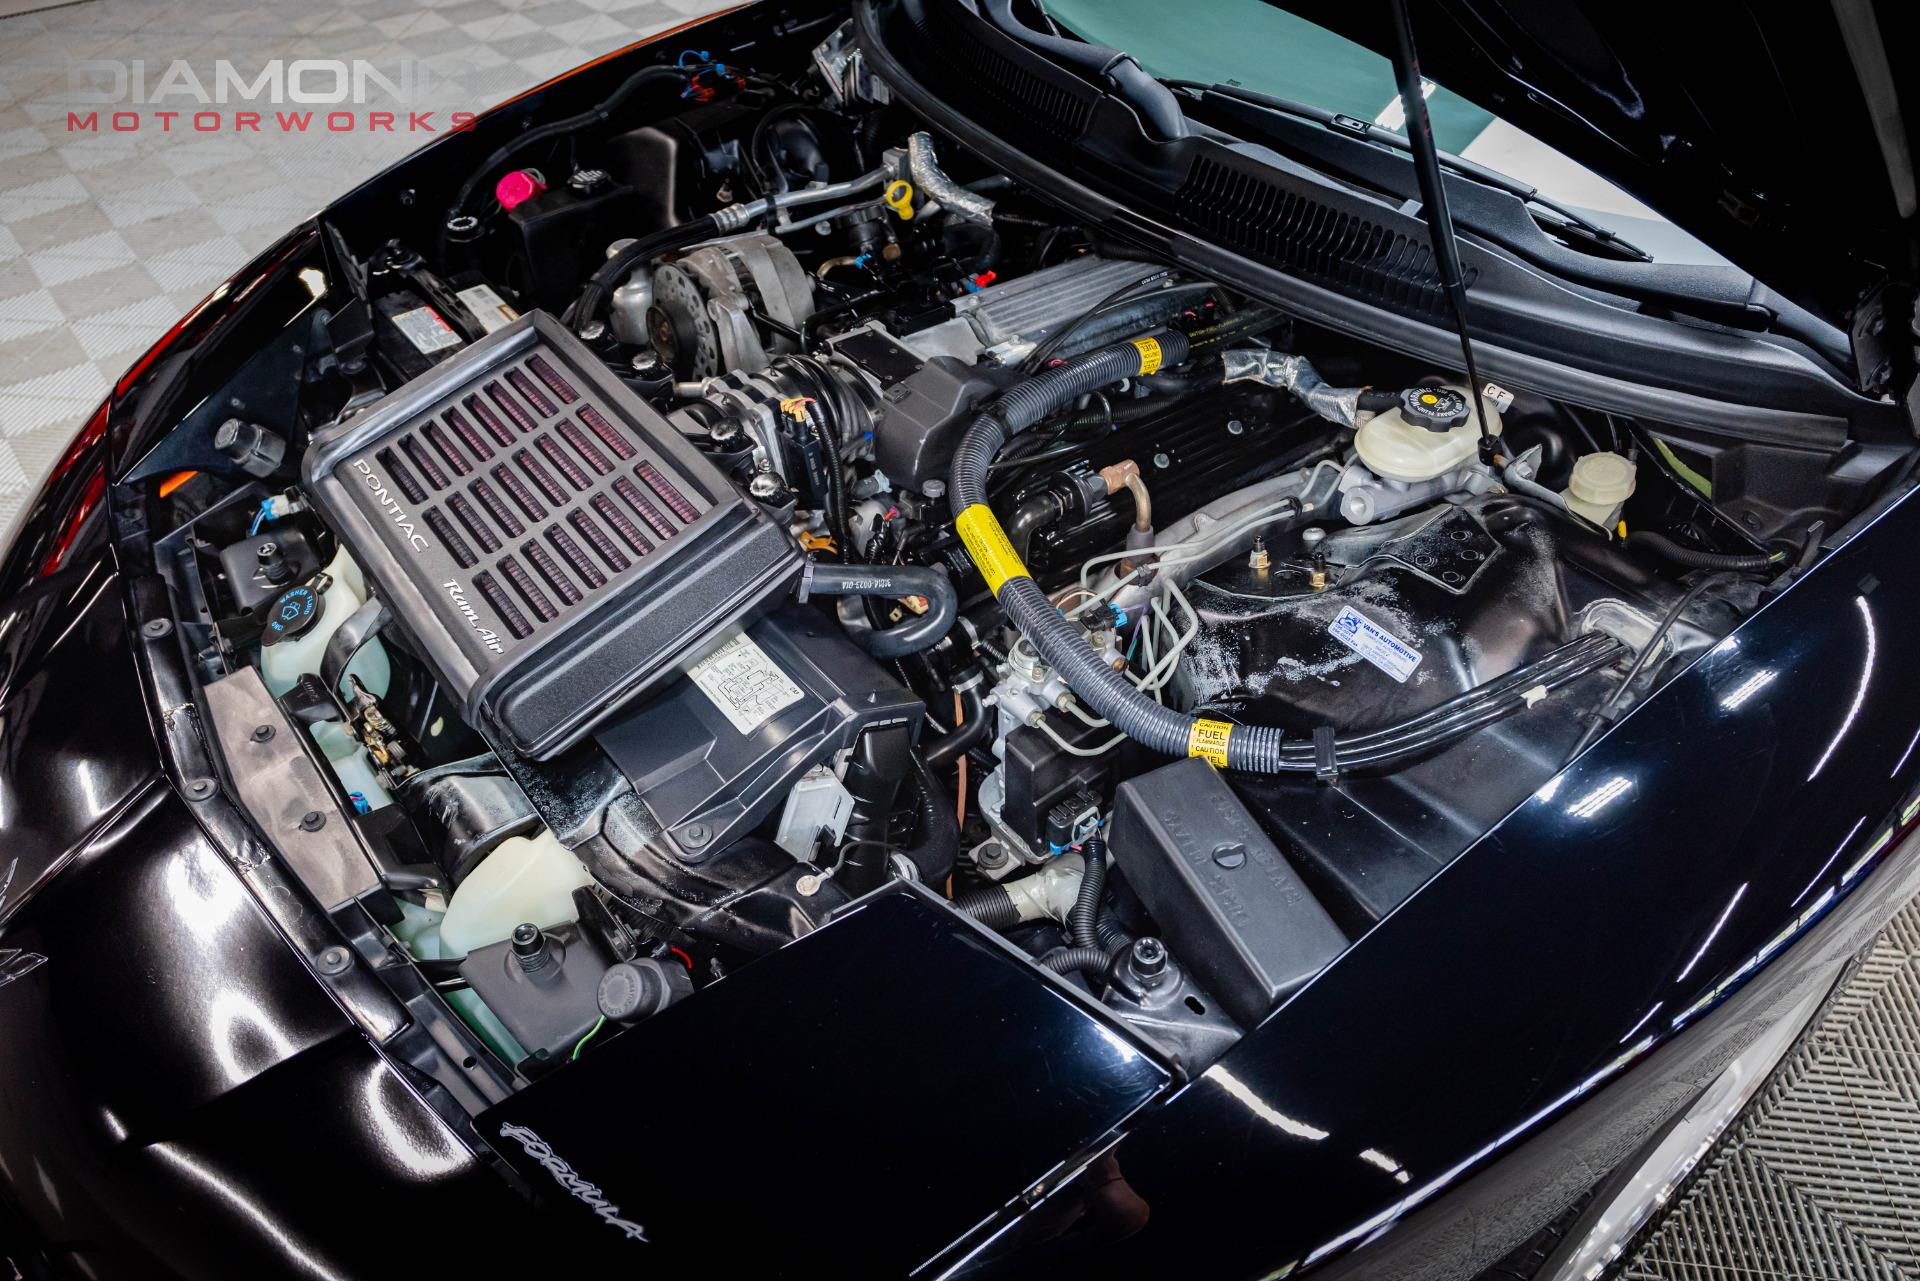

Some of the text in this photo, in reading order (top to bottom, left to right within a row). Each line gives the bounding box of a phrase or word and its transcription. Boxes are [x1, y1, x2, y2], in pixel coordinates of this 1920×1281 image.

[354, 458, 429, 552] PONTIAC
[280, 588, 308, 603] WASHER
[303, 595, 313, 615] FLUID
[443, 578, 504, 654] Ram Air
[1363, 623, 1379, 637] VAN'S
[1380, 635, 1417, 662] AUTOMOTIVE
[1195, 746, 1225, 755] CAUTION
[1198, 729, 1226, 740] FUEL
[500, 1122, 650, 1243] FORMULA
